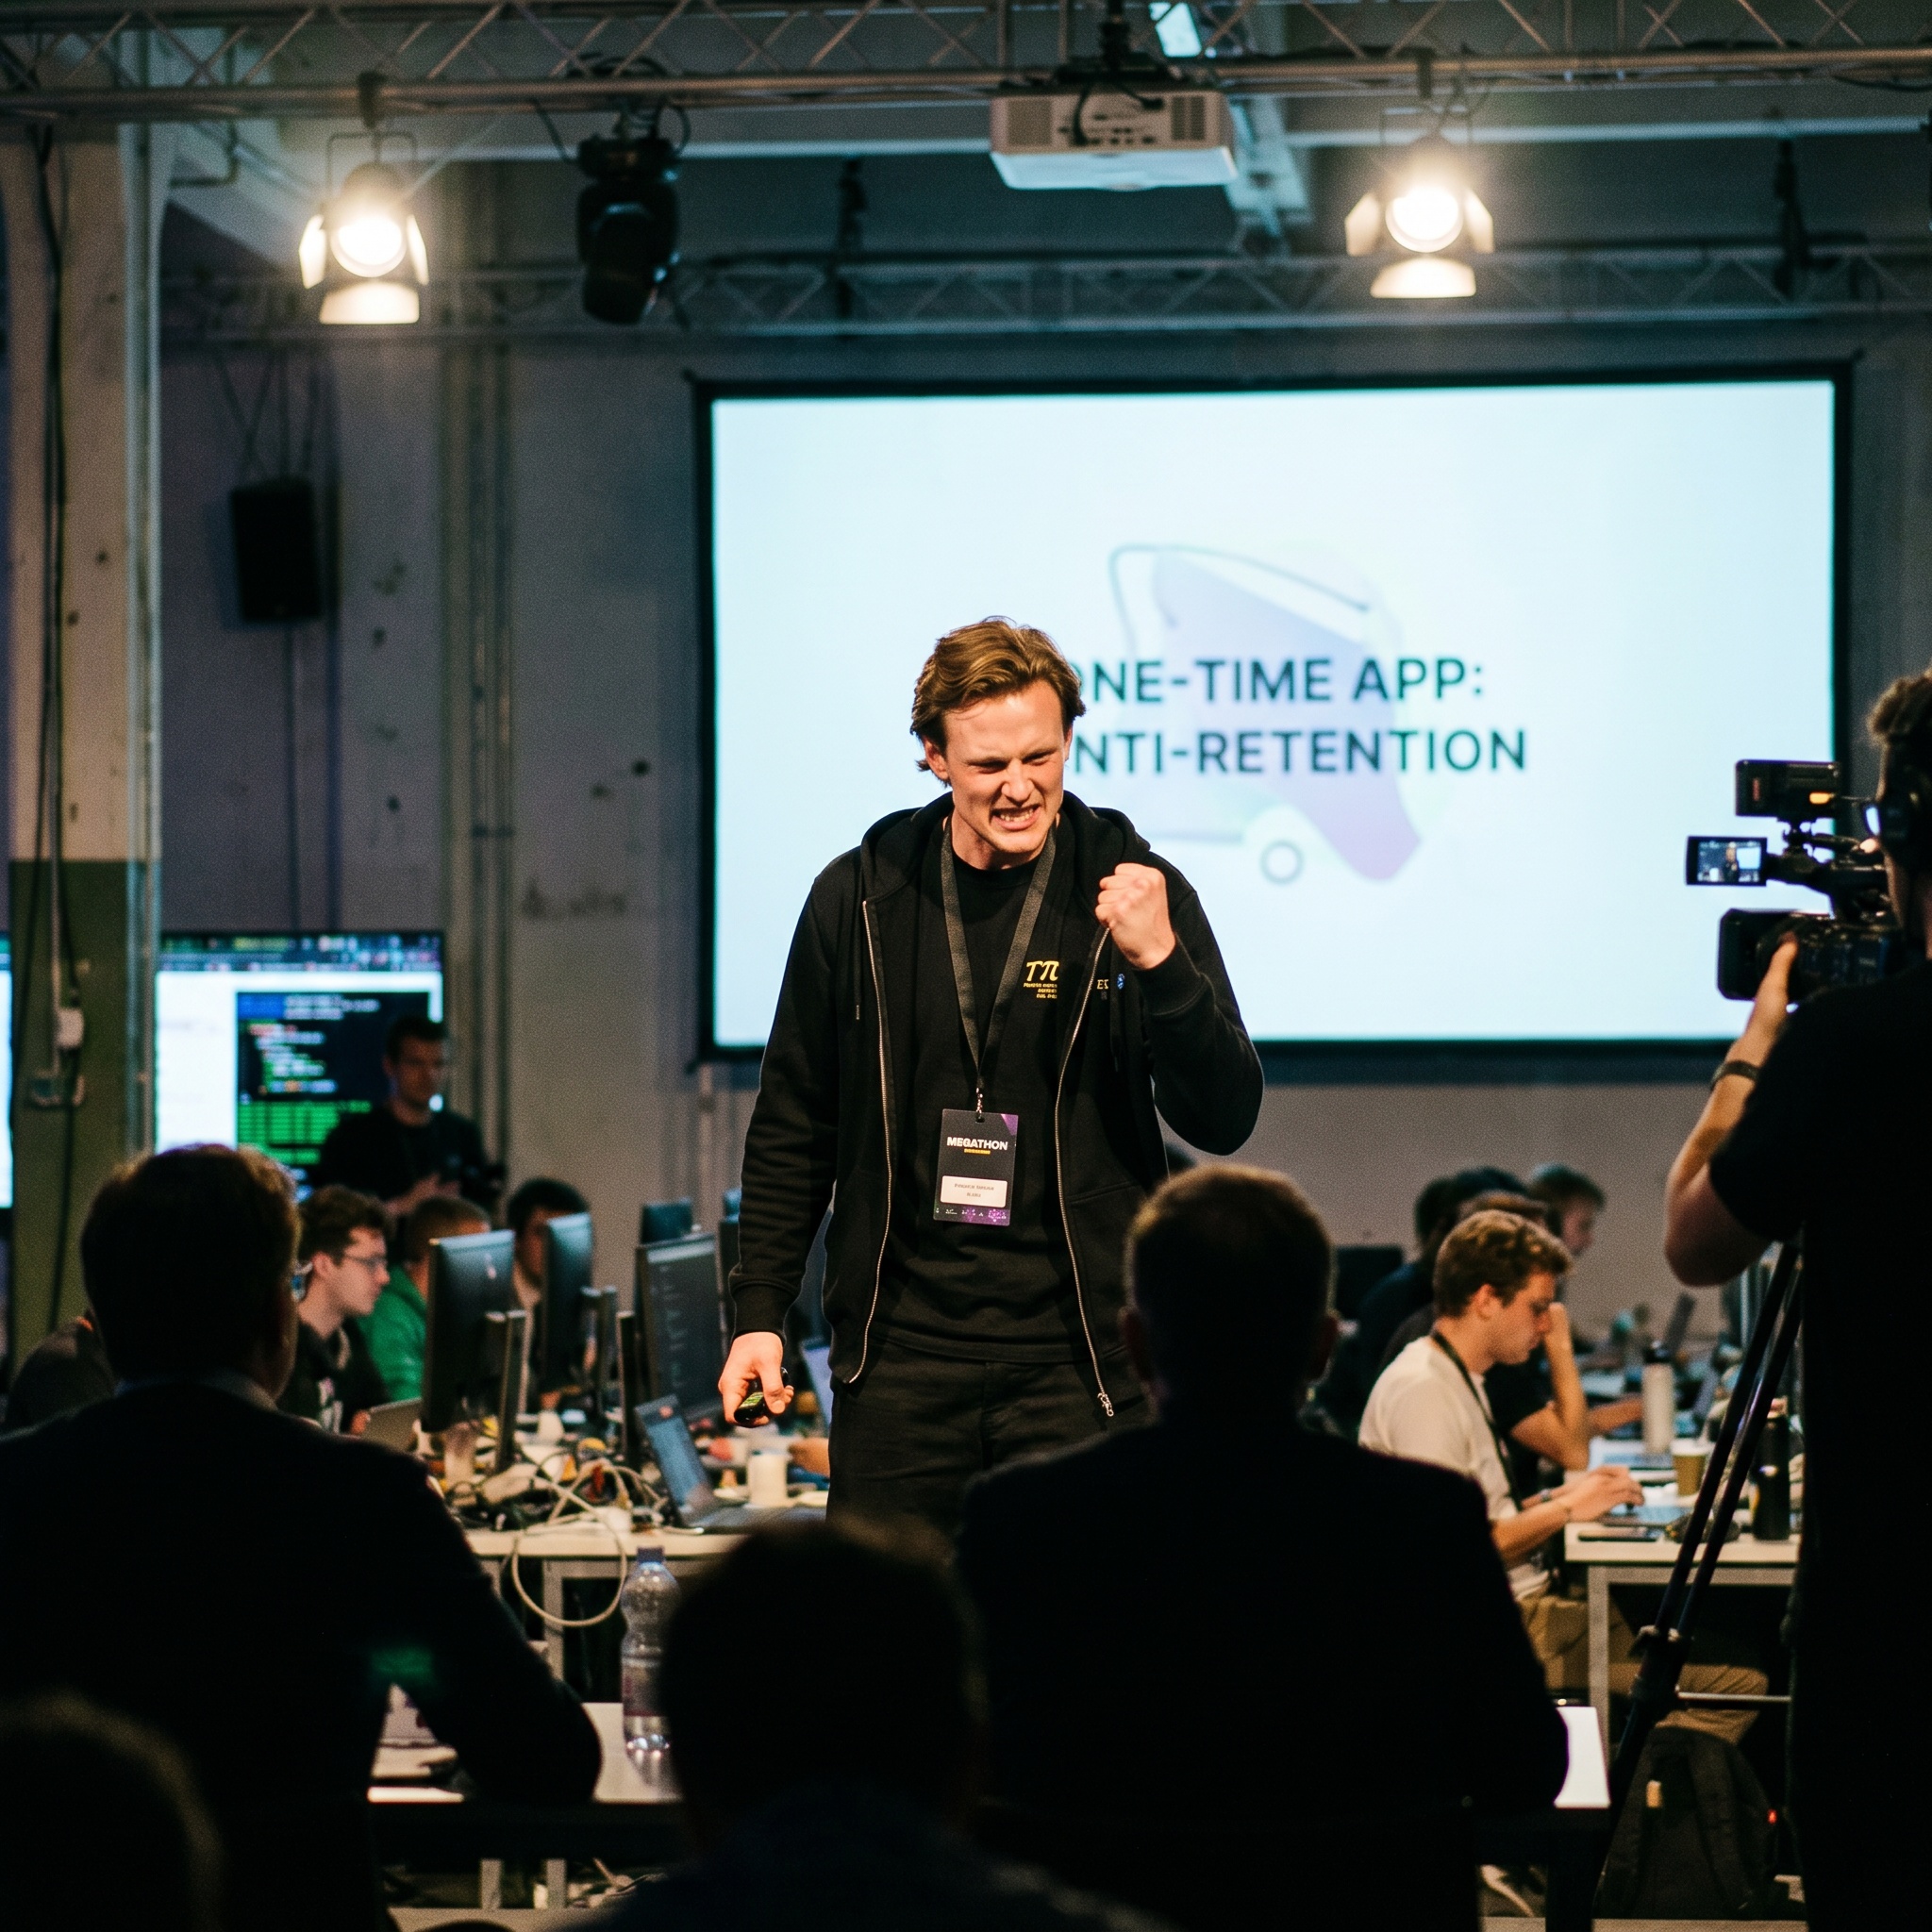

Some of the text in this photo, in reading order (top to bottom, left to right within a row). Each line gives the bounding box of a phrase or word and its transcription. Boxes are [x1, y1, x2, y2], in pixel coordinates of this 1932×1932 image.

[1352, 658, 1484, 701] APP:
[1074, 729, 1526, 773] NTI-RETENTION
[946, 1137, 1008, 1150] MEGATHON
